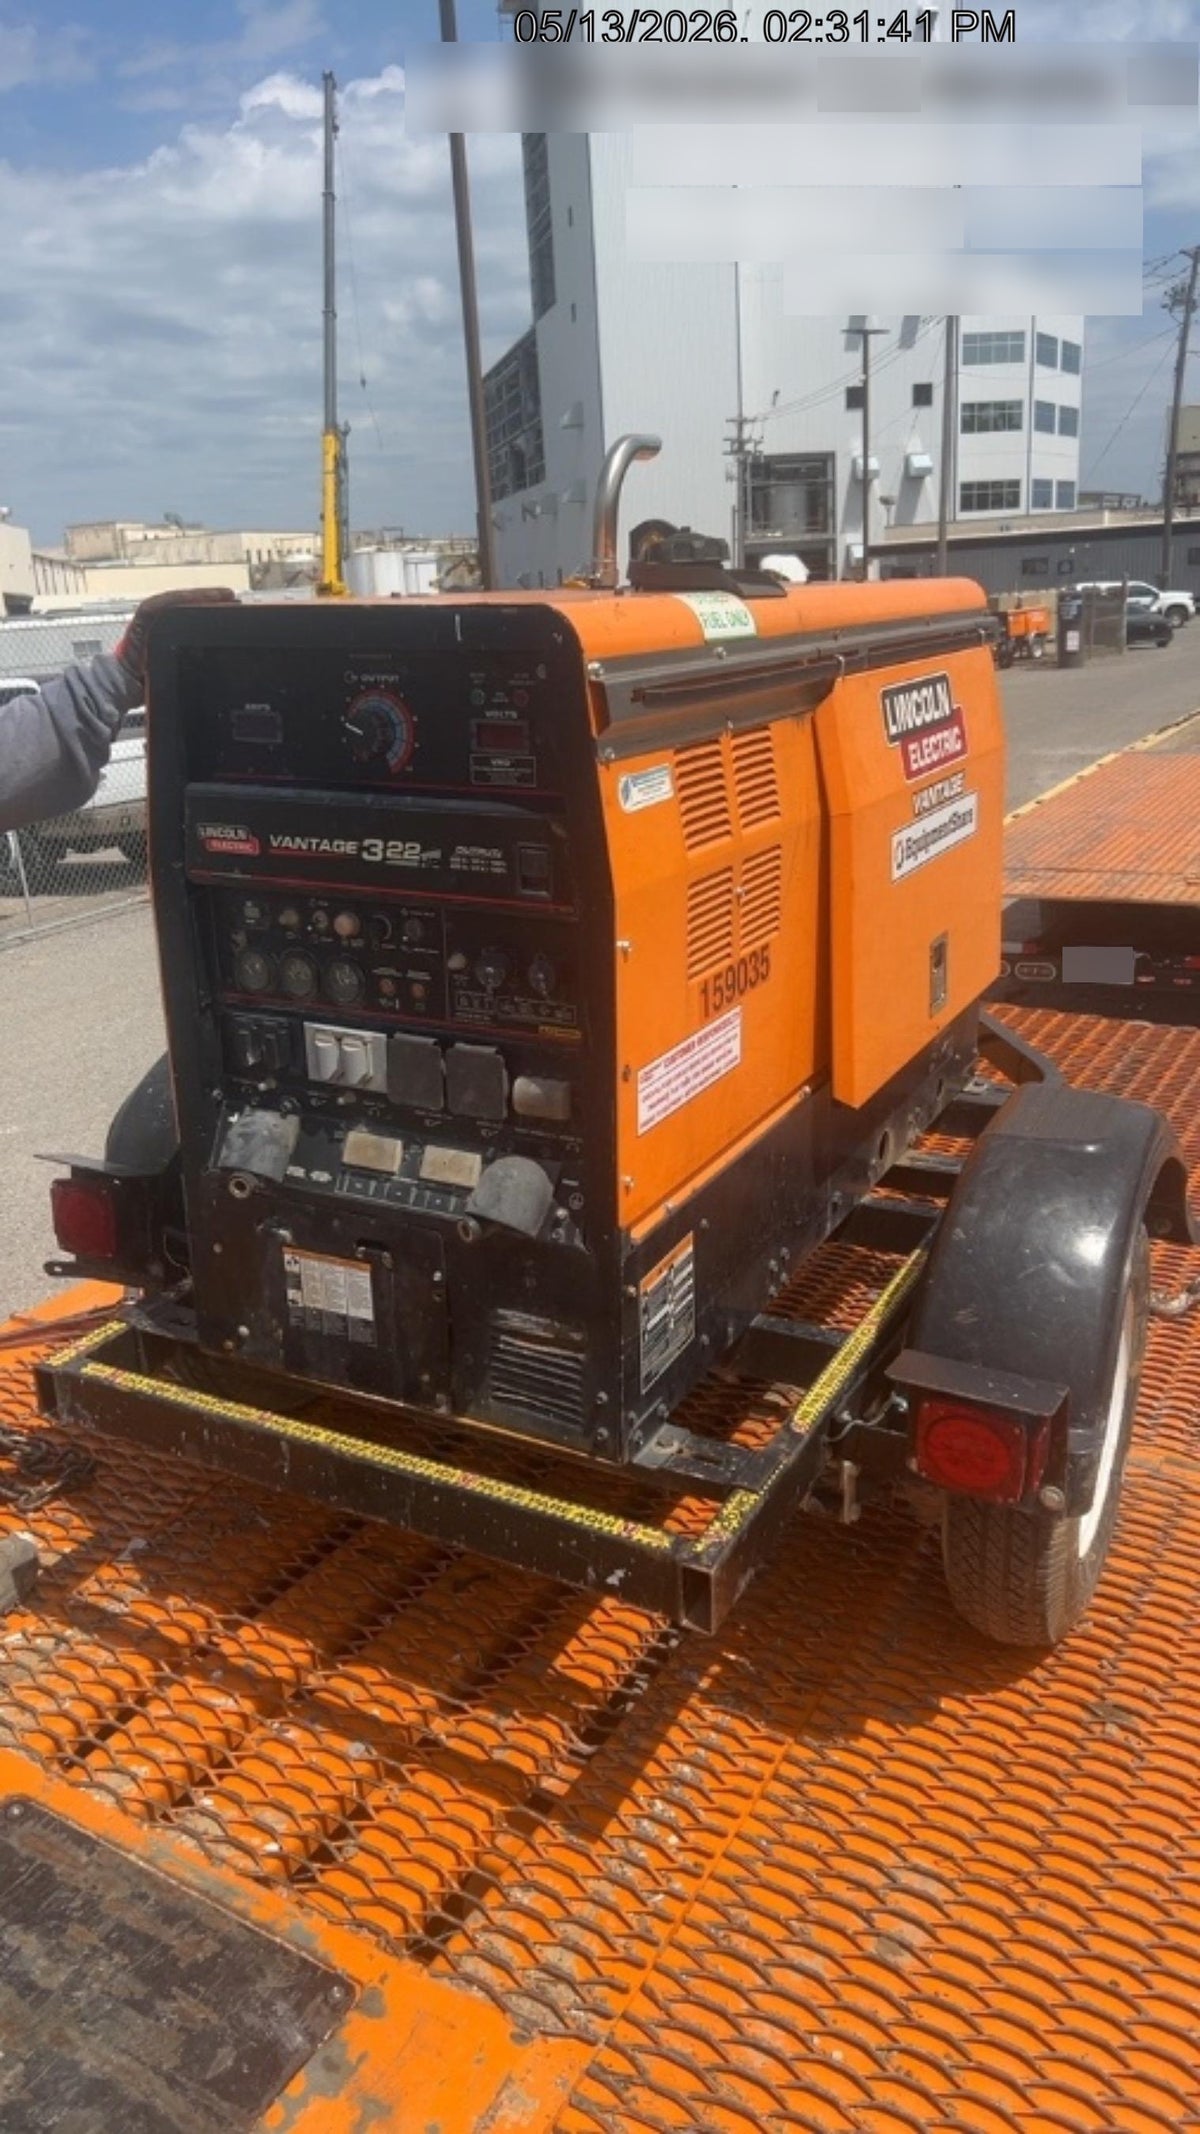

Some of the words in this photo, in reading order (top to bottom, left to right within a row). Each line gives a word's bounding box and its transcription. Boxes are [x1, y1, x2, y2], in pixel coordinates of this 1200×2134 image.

[884, 681, 950, 735] LINCOLN
[907, 726, 962, 772] ELECTRIC
[913, 773, 965, 815] VANTAGE
[269, 834, 359, 855] VANTAGE
[361, 838, 421, 862] 322
[905, 808, 973, 862] EquipmentShare
[700, 943, 771, 1019] 159035
